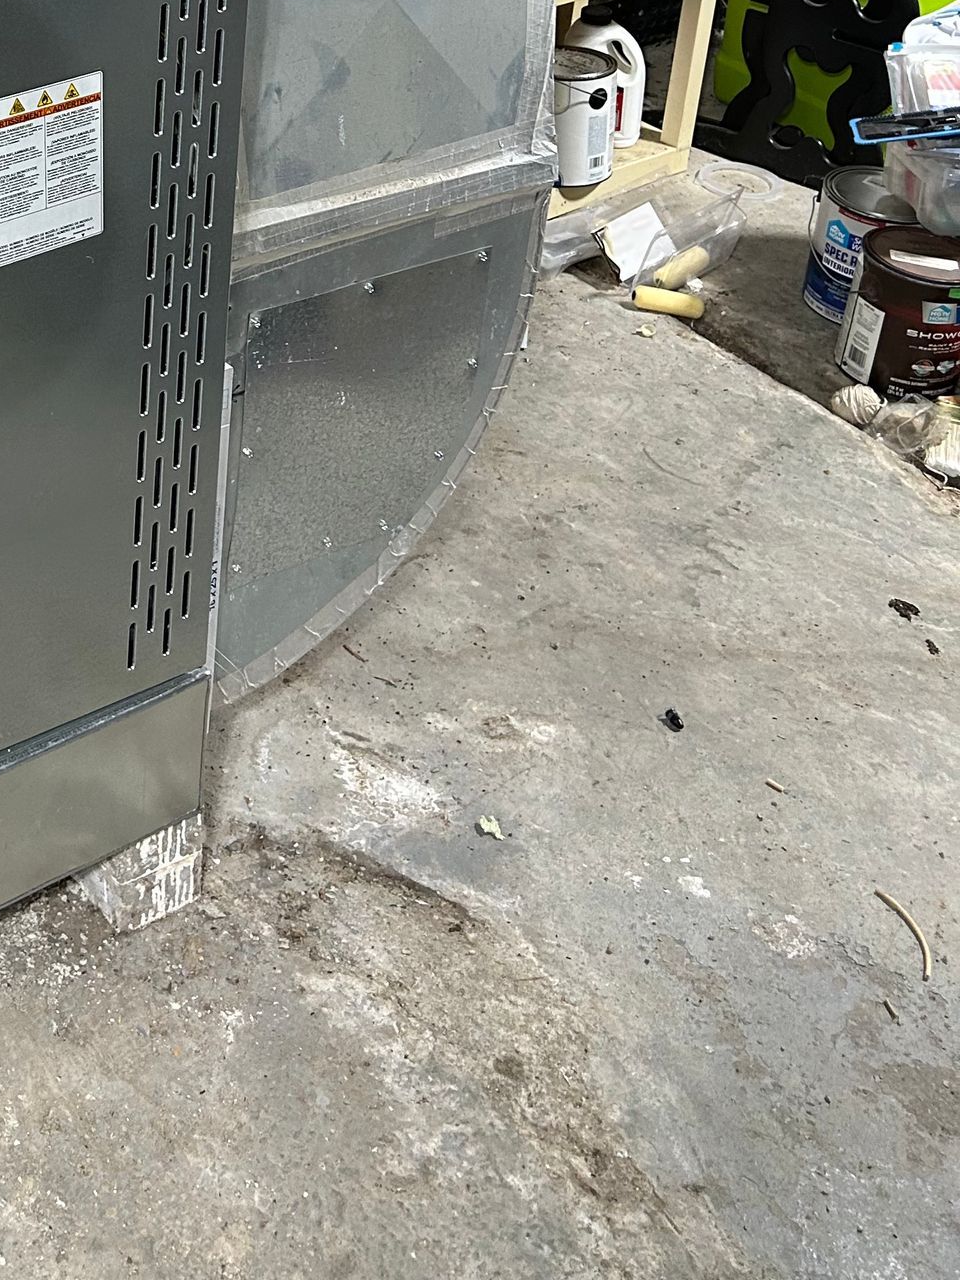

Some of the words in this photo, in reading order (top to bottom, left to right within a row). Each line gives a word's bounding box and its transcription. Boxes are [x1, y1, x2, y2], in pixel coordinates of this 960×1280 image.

[53, 93, 100, 112] ADVERTENCIA
[825, 241, 848, 264] SPEC
[824, 256, 855, 277] INTERIOR
